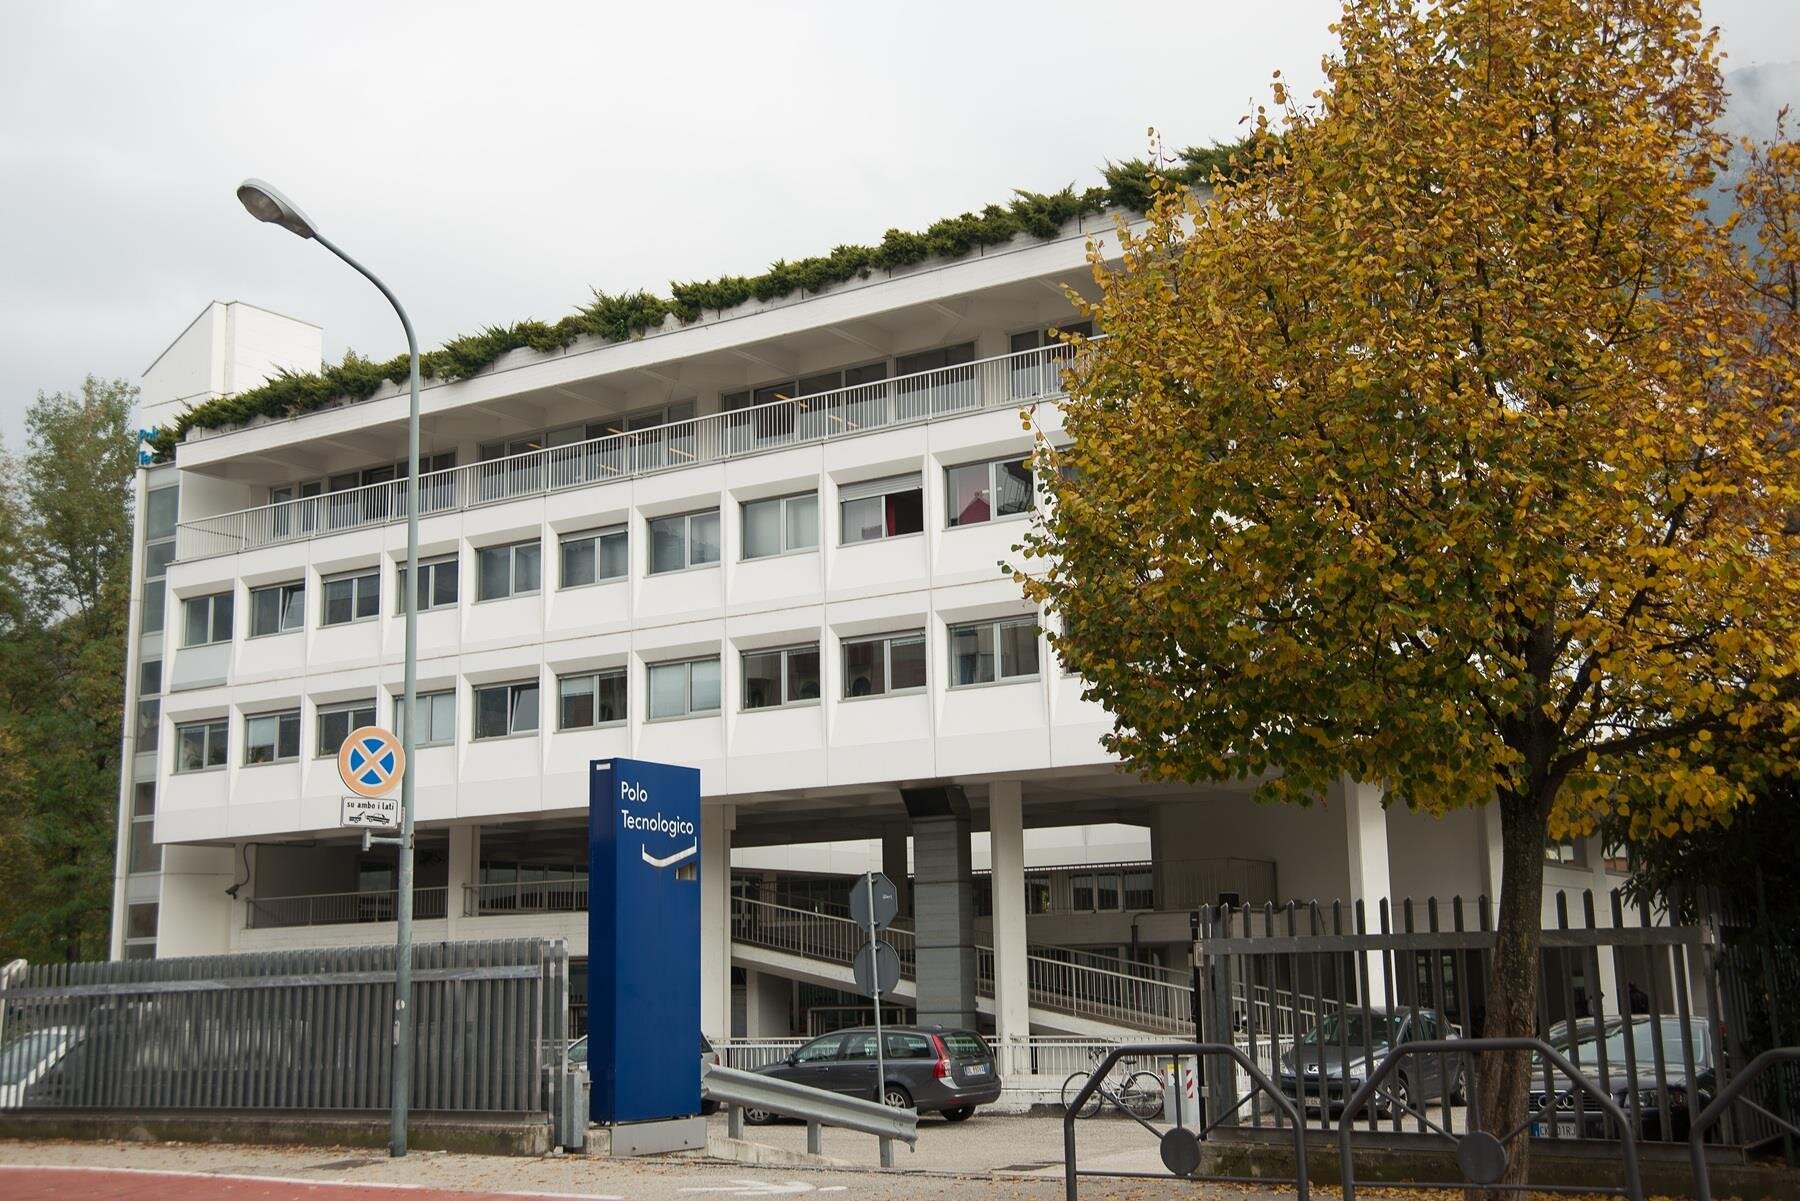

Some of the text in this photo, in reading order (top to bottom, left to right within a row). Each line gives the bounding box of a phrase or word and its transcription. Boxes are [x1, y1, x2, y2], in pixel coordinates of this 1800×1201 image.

[621, 780, 648, 802] Polo
[357, 801, 376, 809] ambo
[382, 802, 394, 810] lati
[621, 809, 694, 838] Tecnologico
